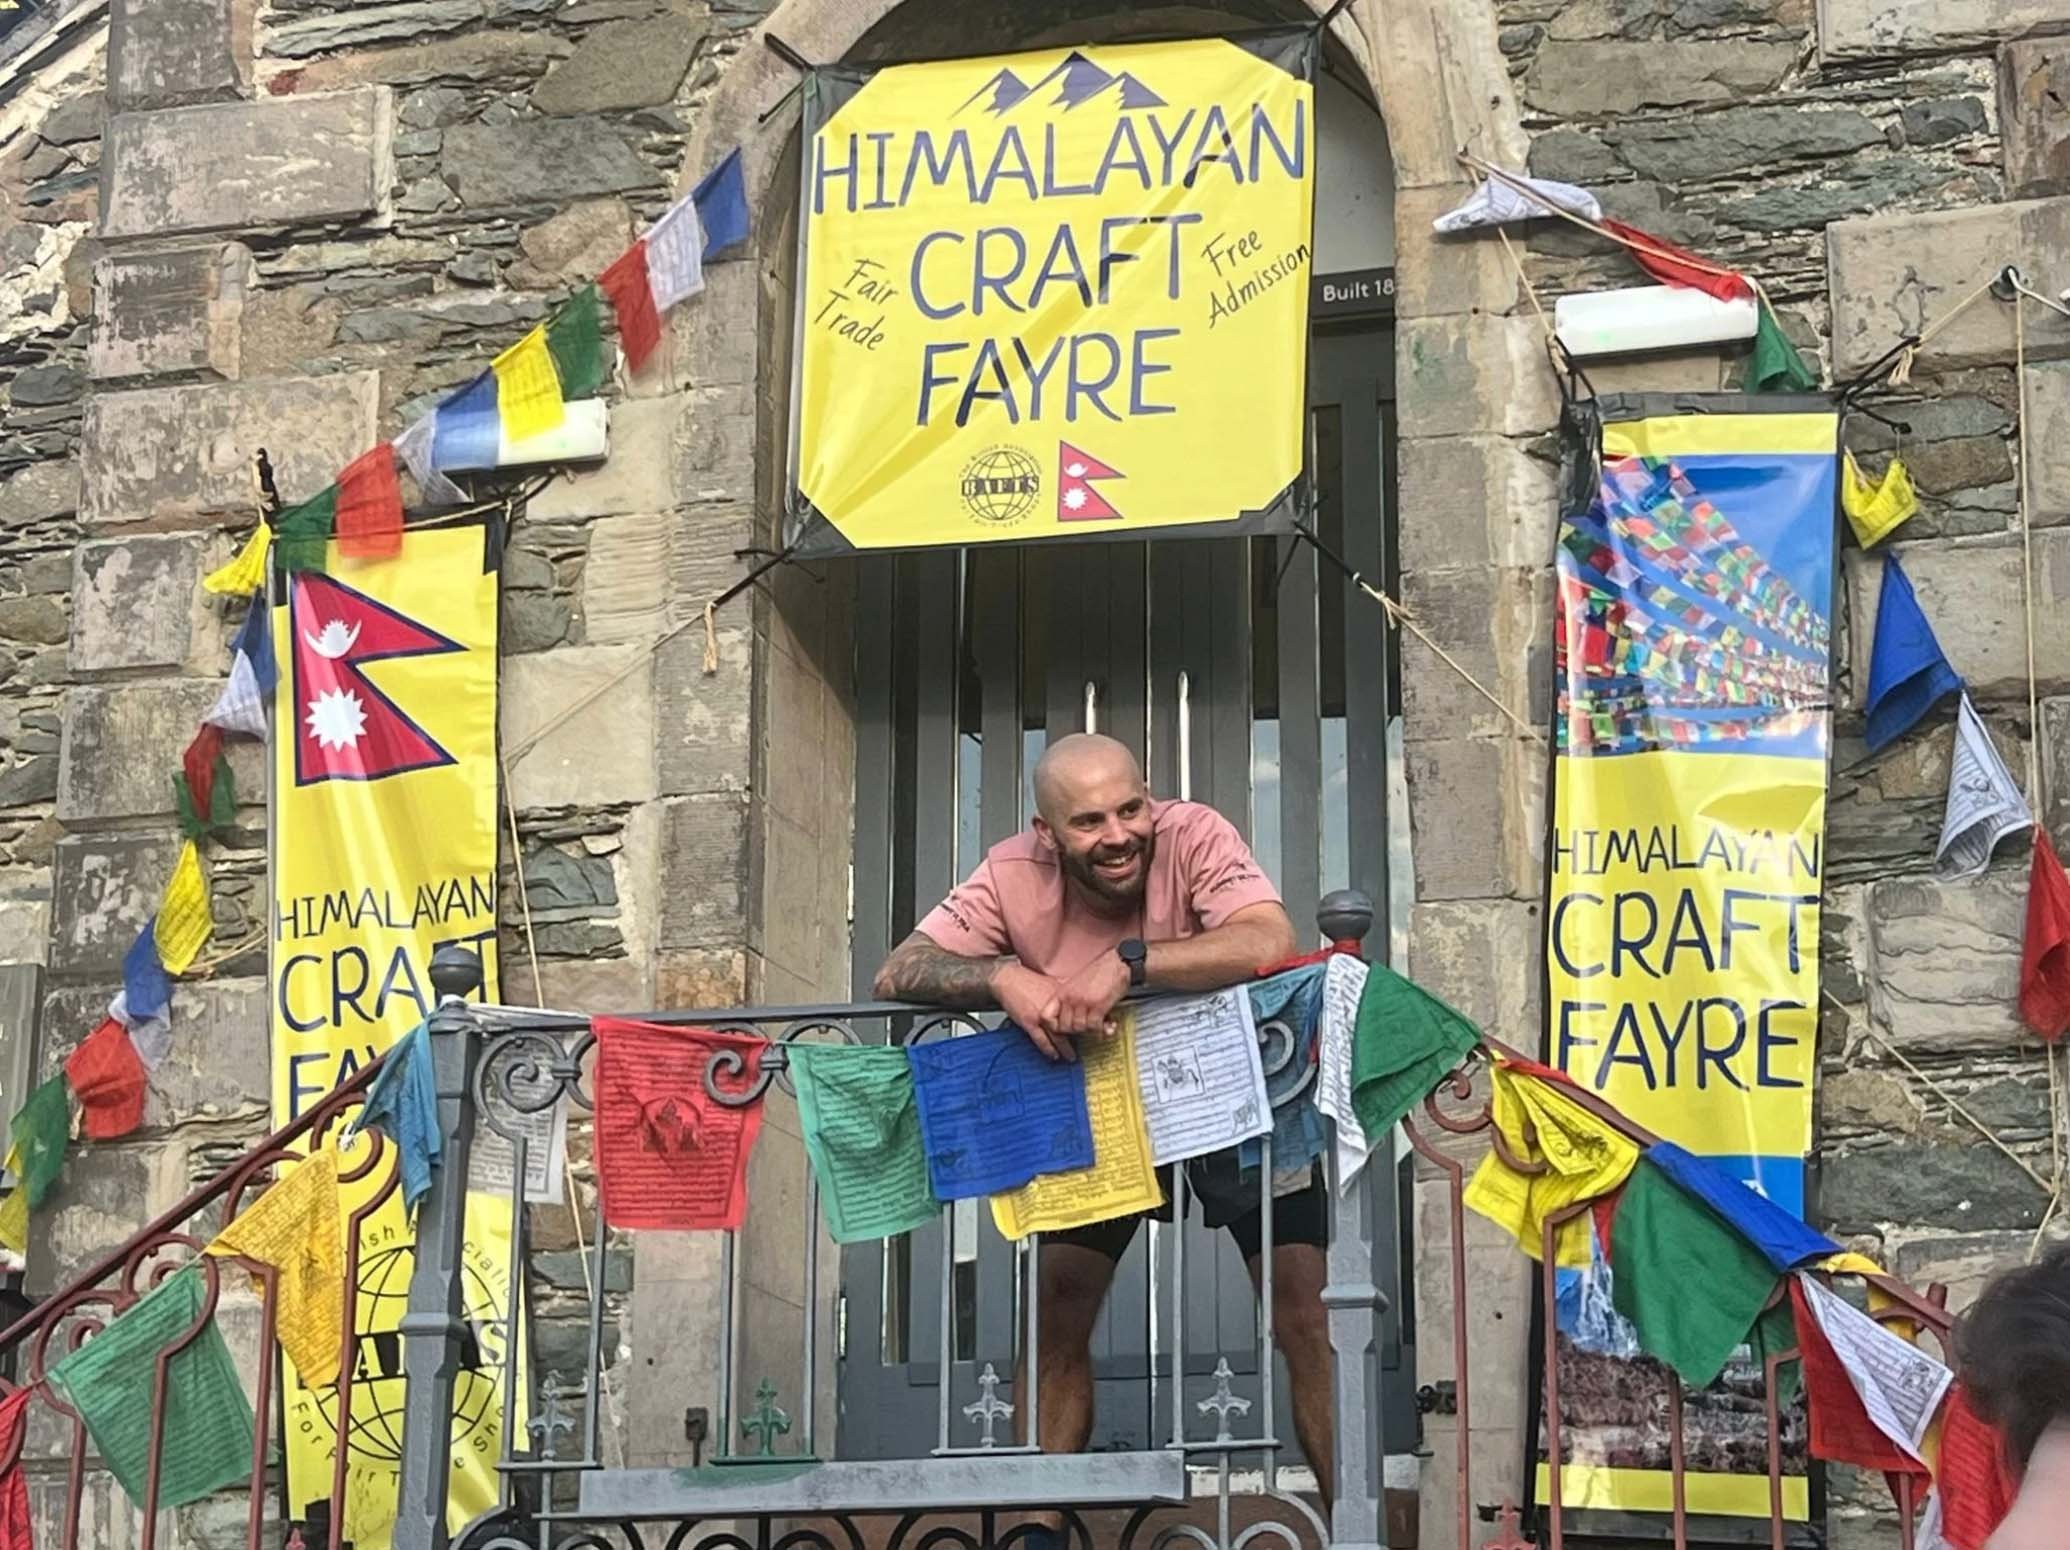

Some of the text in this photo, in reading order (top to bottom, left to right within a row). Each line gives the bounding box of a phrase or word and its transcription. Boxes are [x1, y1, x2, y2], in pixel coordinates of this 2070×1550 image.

[813, 98, 1305, 214] HIMALAYAN
[843, 258, 899, 305] Fair
[910, 213, 1203, 321] CRAFT
[1200, 229, 1263, 277] Free
[1209, 243, 1312, 329] Admission
[1323, 280, 1370, 302] Built
[813, 288, 885, 351] Trade
[916, 328, 1181, 428] FAYRE
[1553, 824, 1819, 878] HIMALAYAN
[276, 871, 494, 941] HIMALAYAN
[1551, 888, 1822, 979] CRAFT
[1557, 998, 1808, 1092] FAYRE
